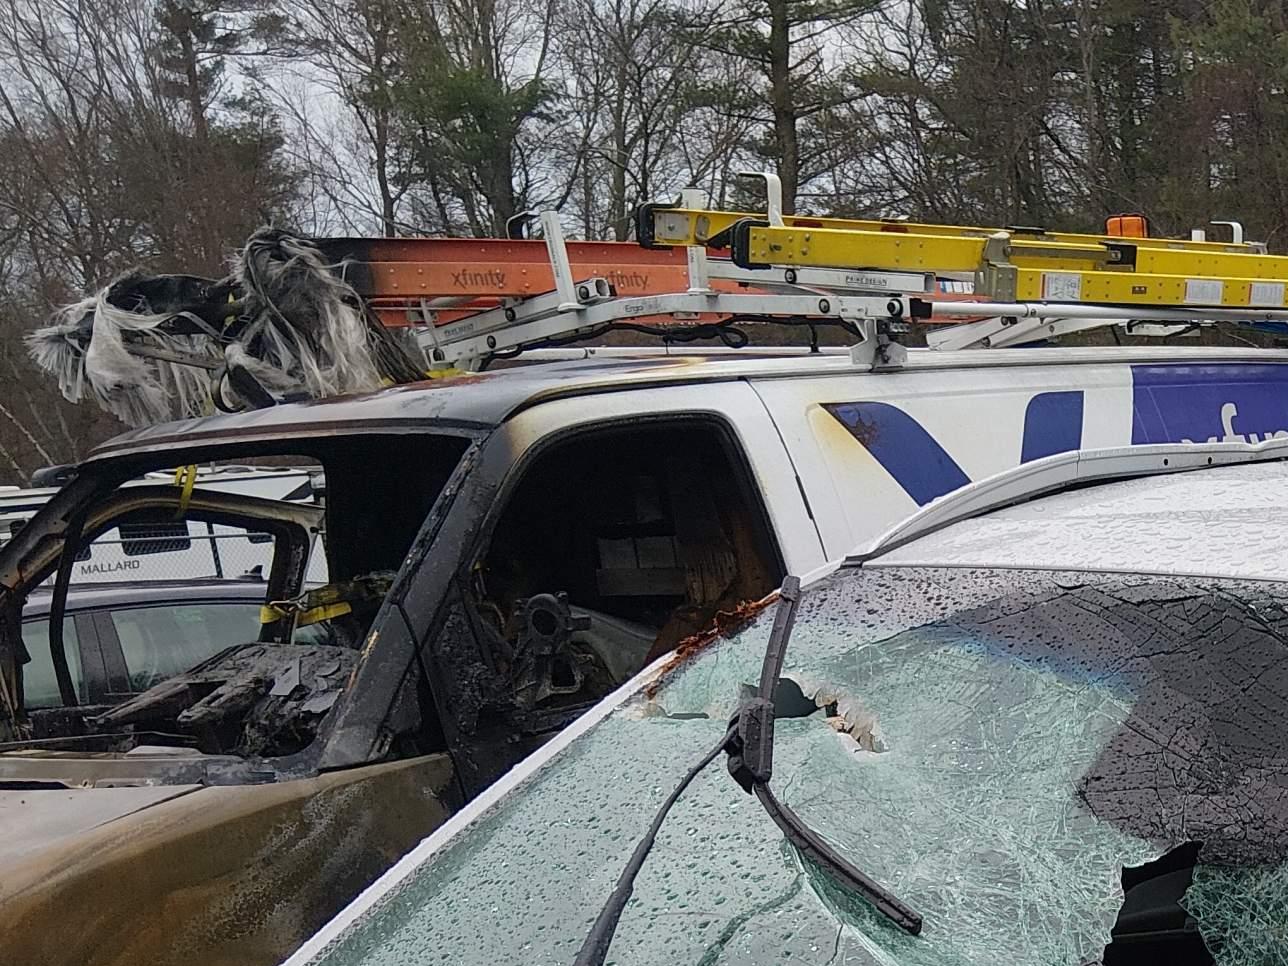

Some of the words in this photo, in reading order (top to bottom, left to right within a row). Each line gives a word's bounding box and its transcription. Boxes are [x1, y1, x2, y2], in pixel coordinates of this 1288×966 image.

[450, 268, 506, 290] xfinity
[605, 271, 650, 291] finity
[80, 559, 141, 576] MALLARD
